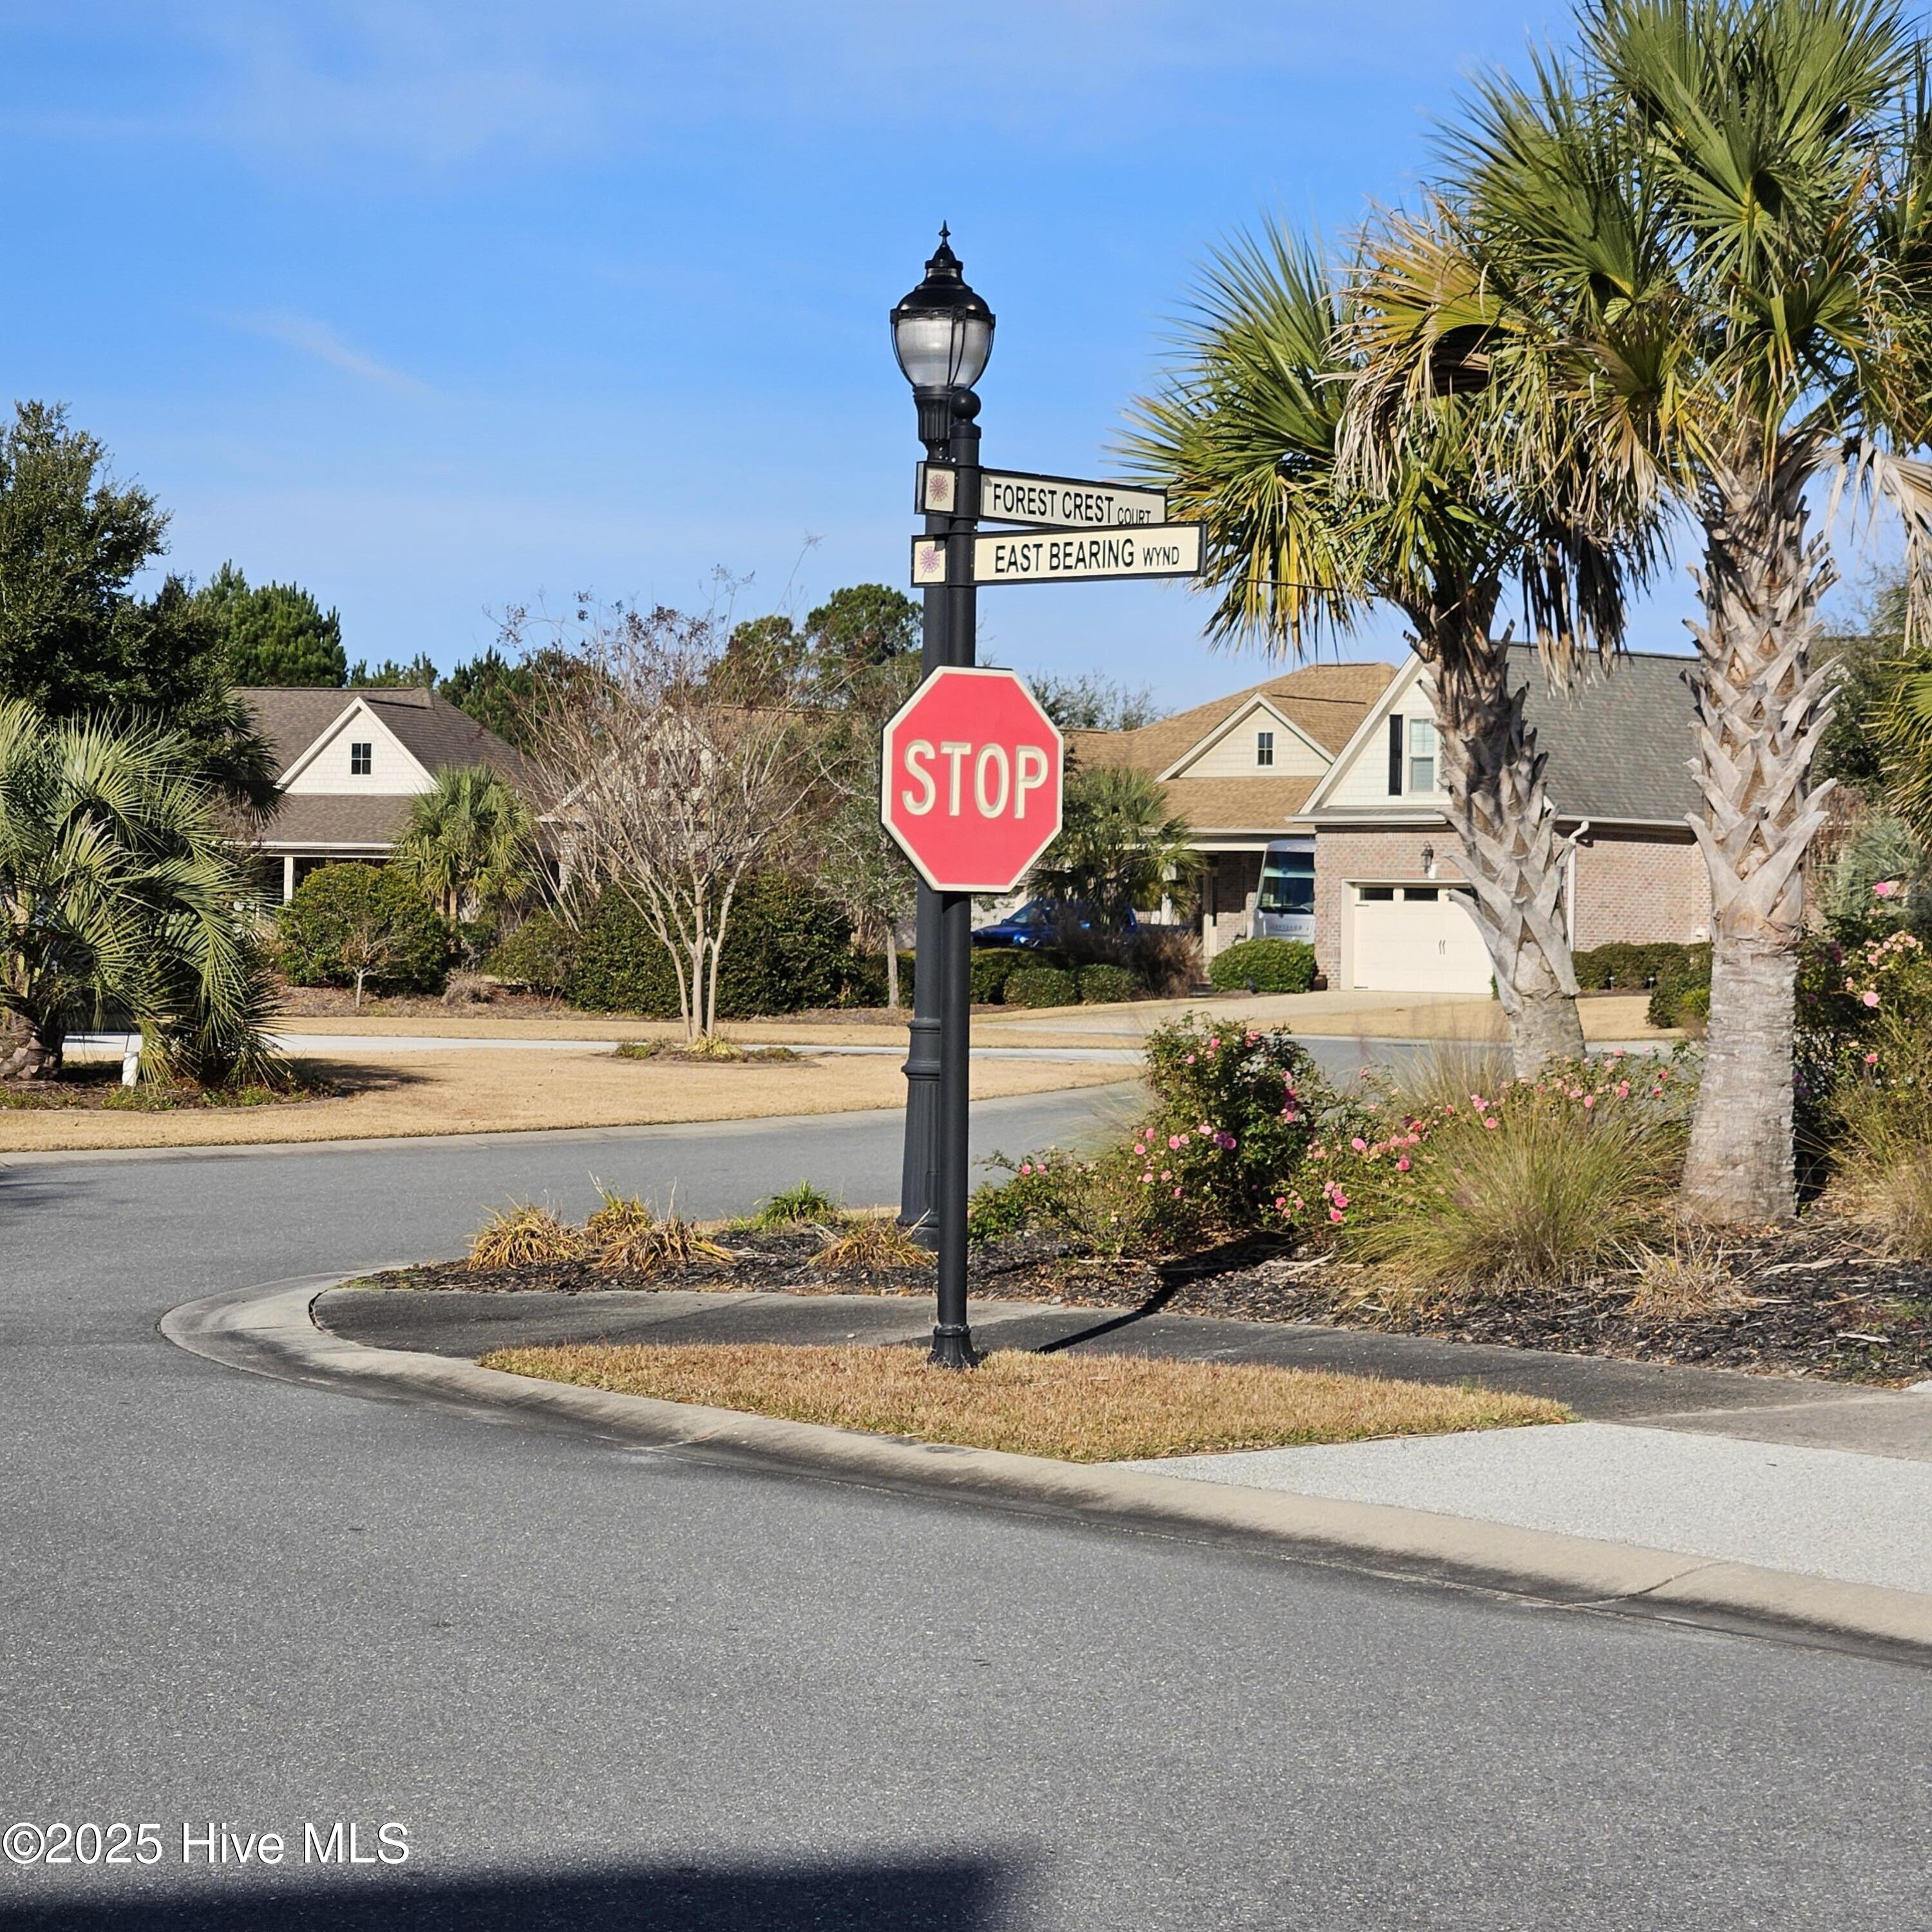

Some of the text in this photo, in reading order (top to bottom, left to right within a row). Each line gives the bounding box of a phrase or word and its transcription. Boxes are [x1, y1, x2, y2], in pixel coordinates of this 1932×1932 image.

[993, 484, 1151, 525] FOREST CREST COURT
[995, 538, 1180, 573] EAST BEARING WYND
[902, 739, 1048, 819] STOP
